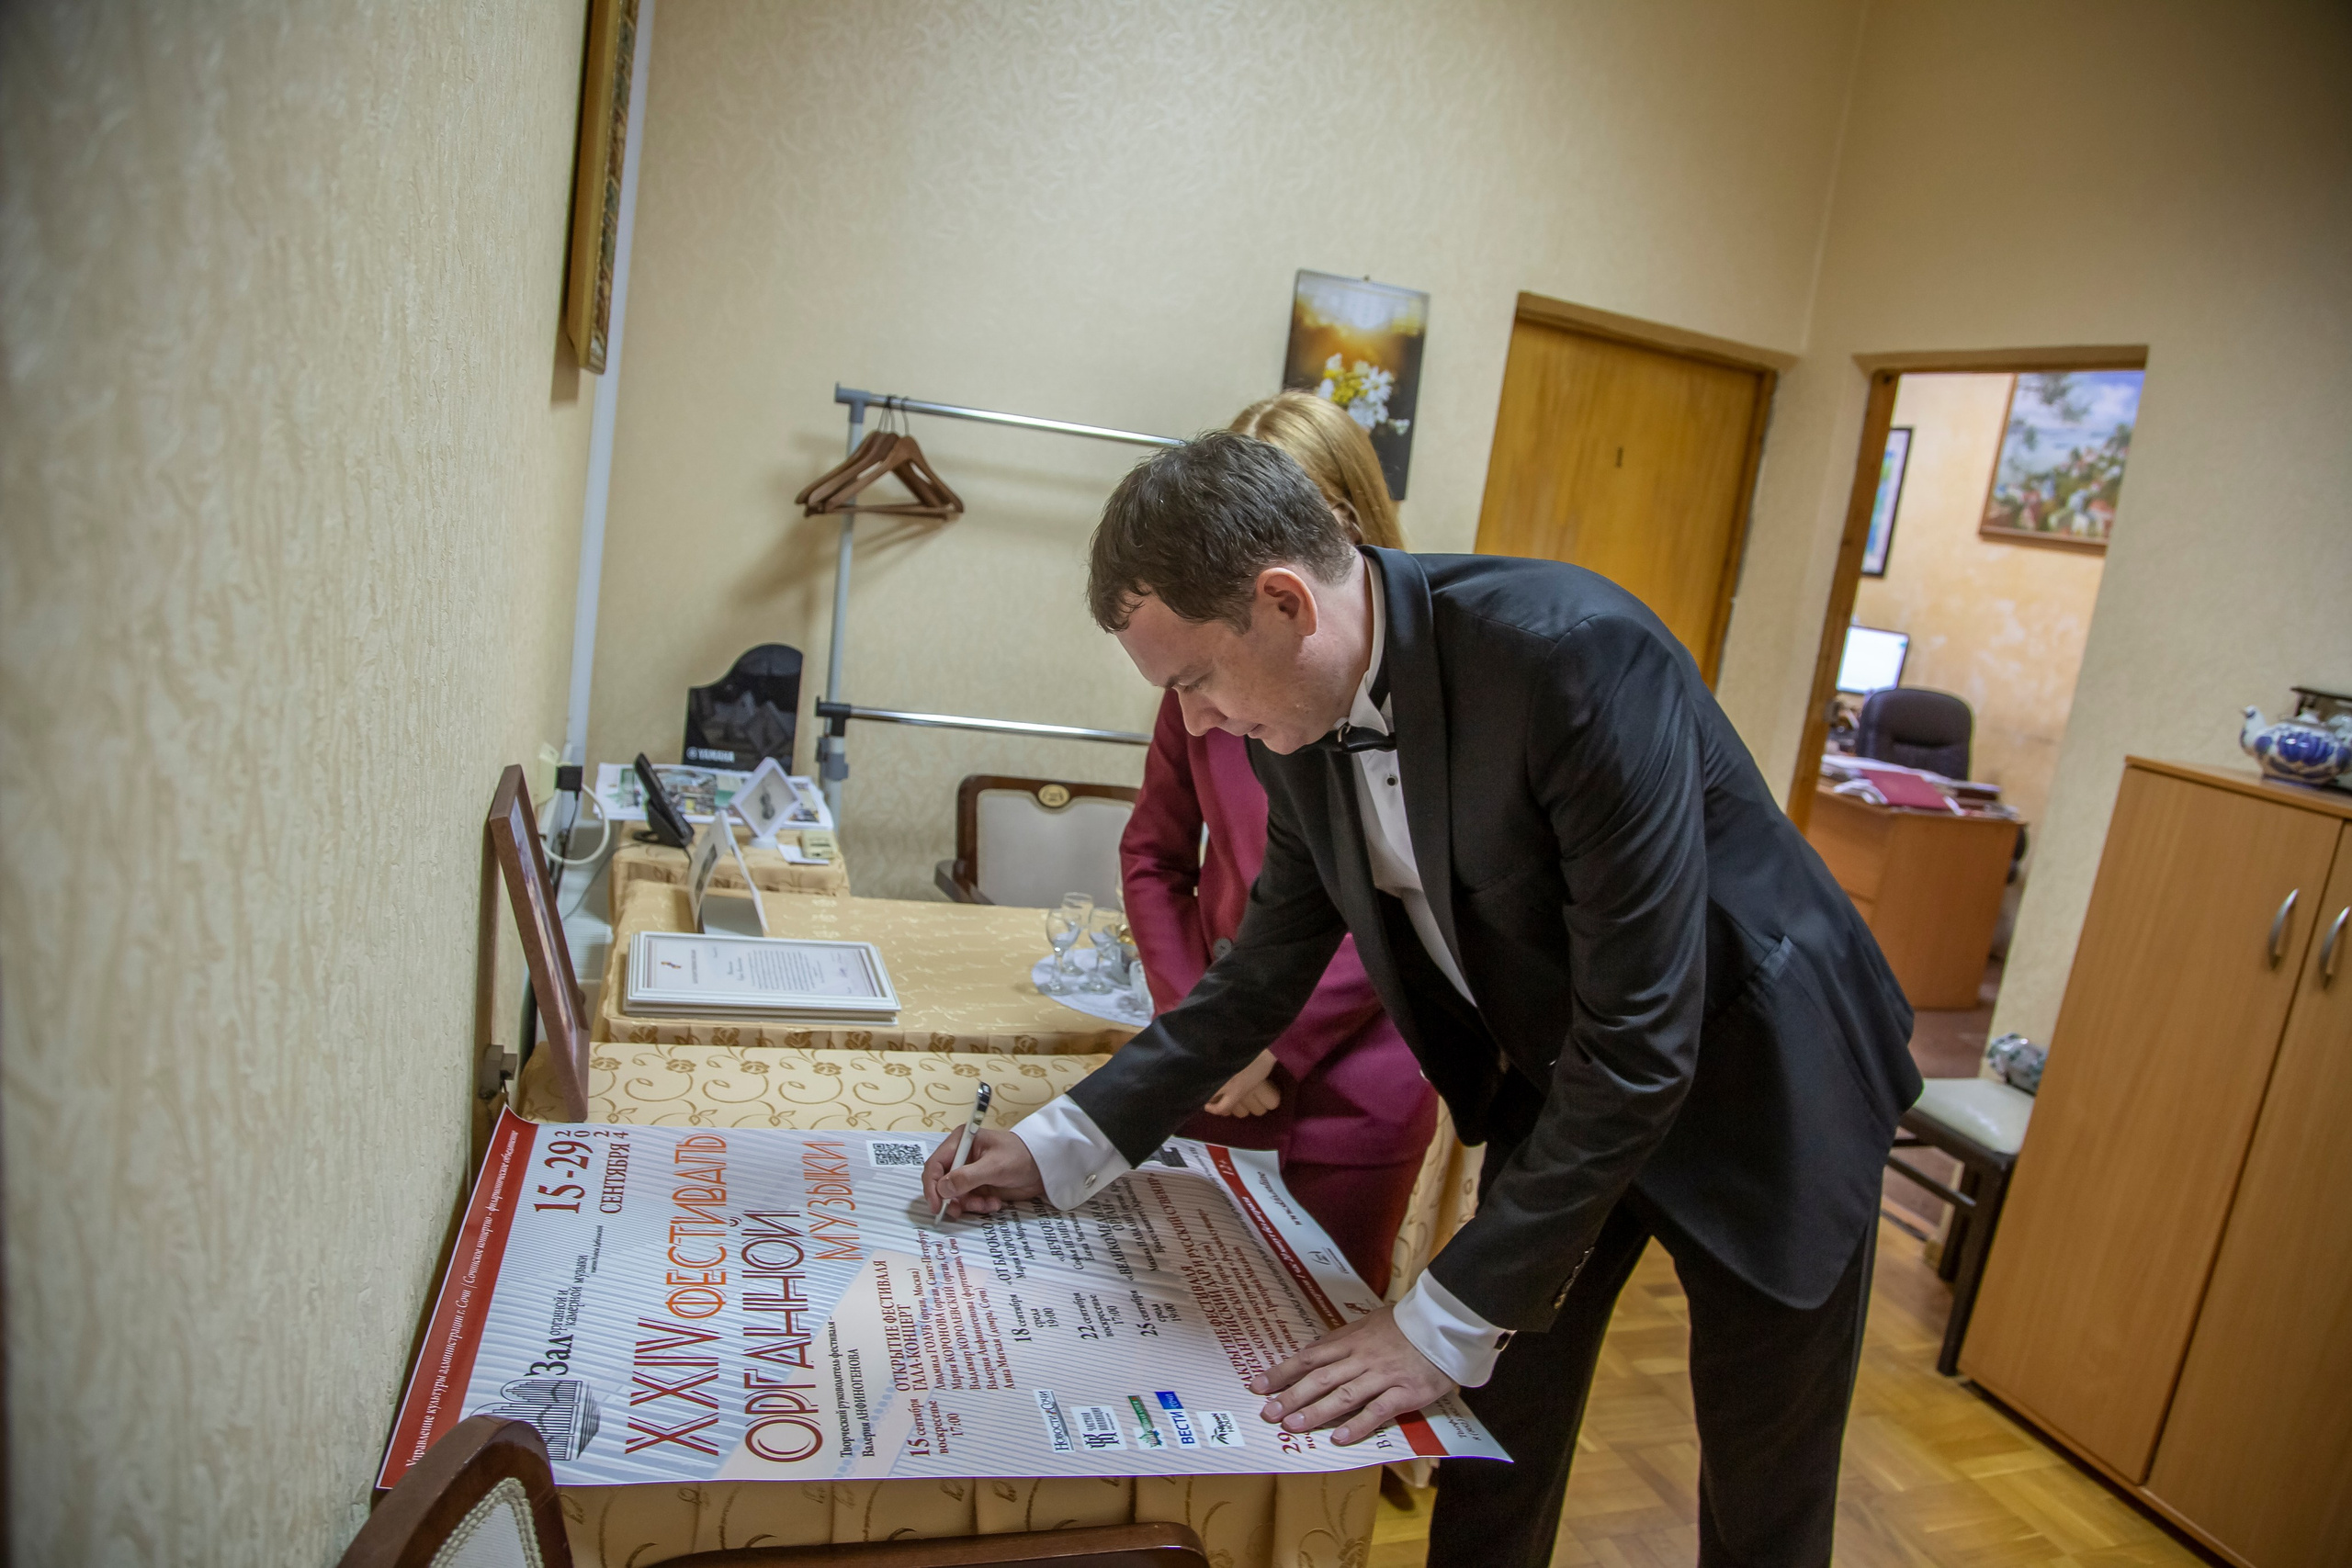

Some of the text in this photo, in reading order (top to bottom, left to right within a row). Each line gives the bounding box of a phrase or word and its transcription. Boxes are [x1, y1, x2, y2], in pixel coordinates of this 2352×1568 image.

[484, 1163, 510, 1212] филармоническое
[599, 1143, 630, 1213] СЕНТЯБРЯ
[802, 1141, 864, 1260] МУЗЫКИ
[476, 1217, 493, 1248] концертно
[980, 1223, 1006, 1265] БАРОККО
[998, 1217, 1019, 1257] КОРОНОВА
[1038, 1220, 1065, 1262] «ВЕЧНОЕ
[1169, 1216, 1200, 1258] РУССКИЙ
[462, 1249, 484, 1283] Сочинское
[996, 1268, 1012, 1285] «ОТ
[1012, 1258, 1026, 1279] Мария
[1198, 1269, 1220, 1288] ДАР
[455, 1290, 472, 1308] Сочи
[563, 1255, 590, 1325] камерной музыки
[624, 1133, 728, 1457] XXIV ФЕСТИВАЛЬ
[912, 1227, 964, 1390] Мария КОРОНОВА (орган, Санкт-Петербург)
[976, 1287, 991, 1309] Сочи)
[1181, 1265, 1223, 1326] ФЕСТИВАЛЯ
[551, 1297, 566, 1336] органной
[873, 1260, 910, 1392] ОТКРЫТИЕ ФЕСТИВАЛЯ
[907, 1268, 946, 1391] Людмила ГОЛУБ (орган, Москва)
[931, 1241, 981, 1390] Владимир КОРОЛЕВСКИЙ (орган, Сочи)
[967, 1301, 989, 1356] Анфиногенова
[1008, 1293, 1033, 1342] 18 сентября
[1031, 1308, 1046, 1328] среда
[1046, 1307, 1059, 1328] 19:00
[1071, 1292, 1099, 1340] 22 сентября
[1090, 1294, 1114, 1337] воскресенье
[1107, 1305, 1125, 1325] 17:00
[1128, 1290, 1159, 1337] 25 сентября
[1151, 1303, 1166, 1323] среда
[1165, 1303, 1182, 1322] 19:00
[1227, 1286, 1267, 1349] КОРОЛЕВСКИЙ
[438, 1315, 464, 1374] администрации
[524, 1334, 574, 1376] Зал
[729, 1210, 823, 1463] ОРГАННОЙ
[828, 1321, 842, 1359] фестиваля
[896, 1303, 928, 1392] ГАЛА-КОНЦЕРТ
[992, 1338, 1009, 1368] Мягкая
[1259, 1316, 1284, 1354] народных
[832, 1359, 851, 1409] руководитель
[980, 1357, 998, 1390] Валерия
[1001, 1369, 1016, 1390] Анна
[428, 1376, 448, 1414] культуры
[847, 1348, 876, 1457] Валерия АНФИНОГЕНОВА
[405, 1416, 435, 1467] Управление
[835, 1410, 854, 1458] Творческий
[907, 1398, 931, 1457] 15 сентября
[928, 1400, 949, 1454] воскресенье
[947, 1413, 964, 1437] 17:00
[1169, 1411, 1195, 1444] ВЕСТИ
[1220, 1414, 1235, 1432] HOUSE
[1277, 1432, 1303, 1454] 29
